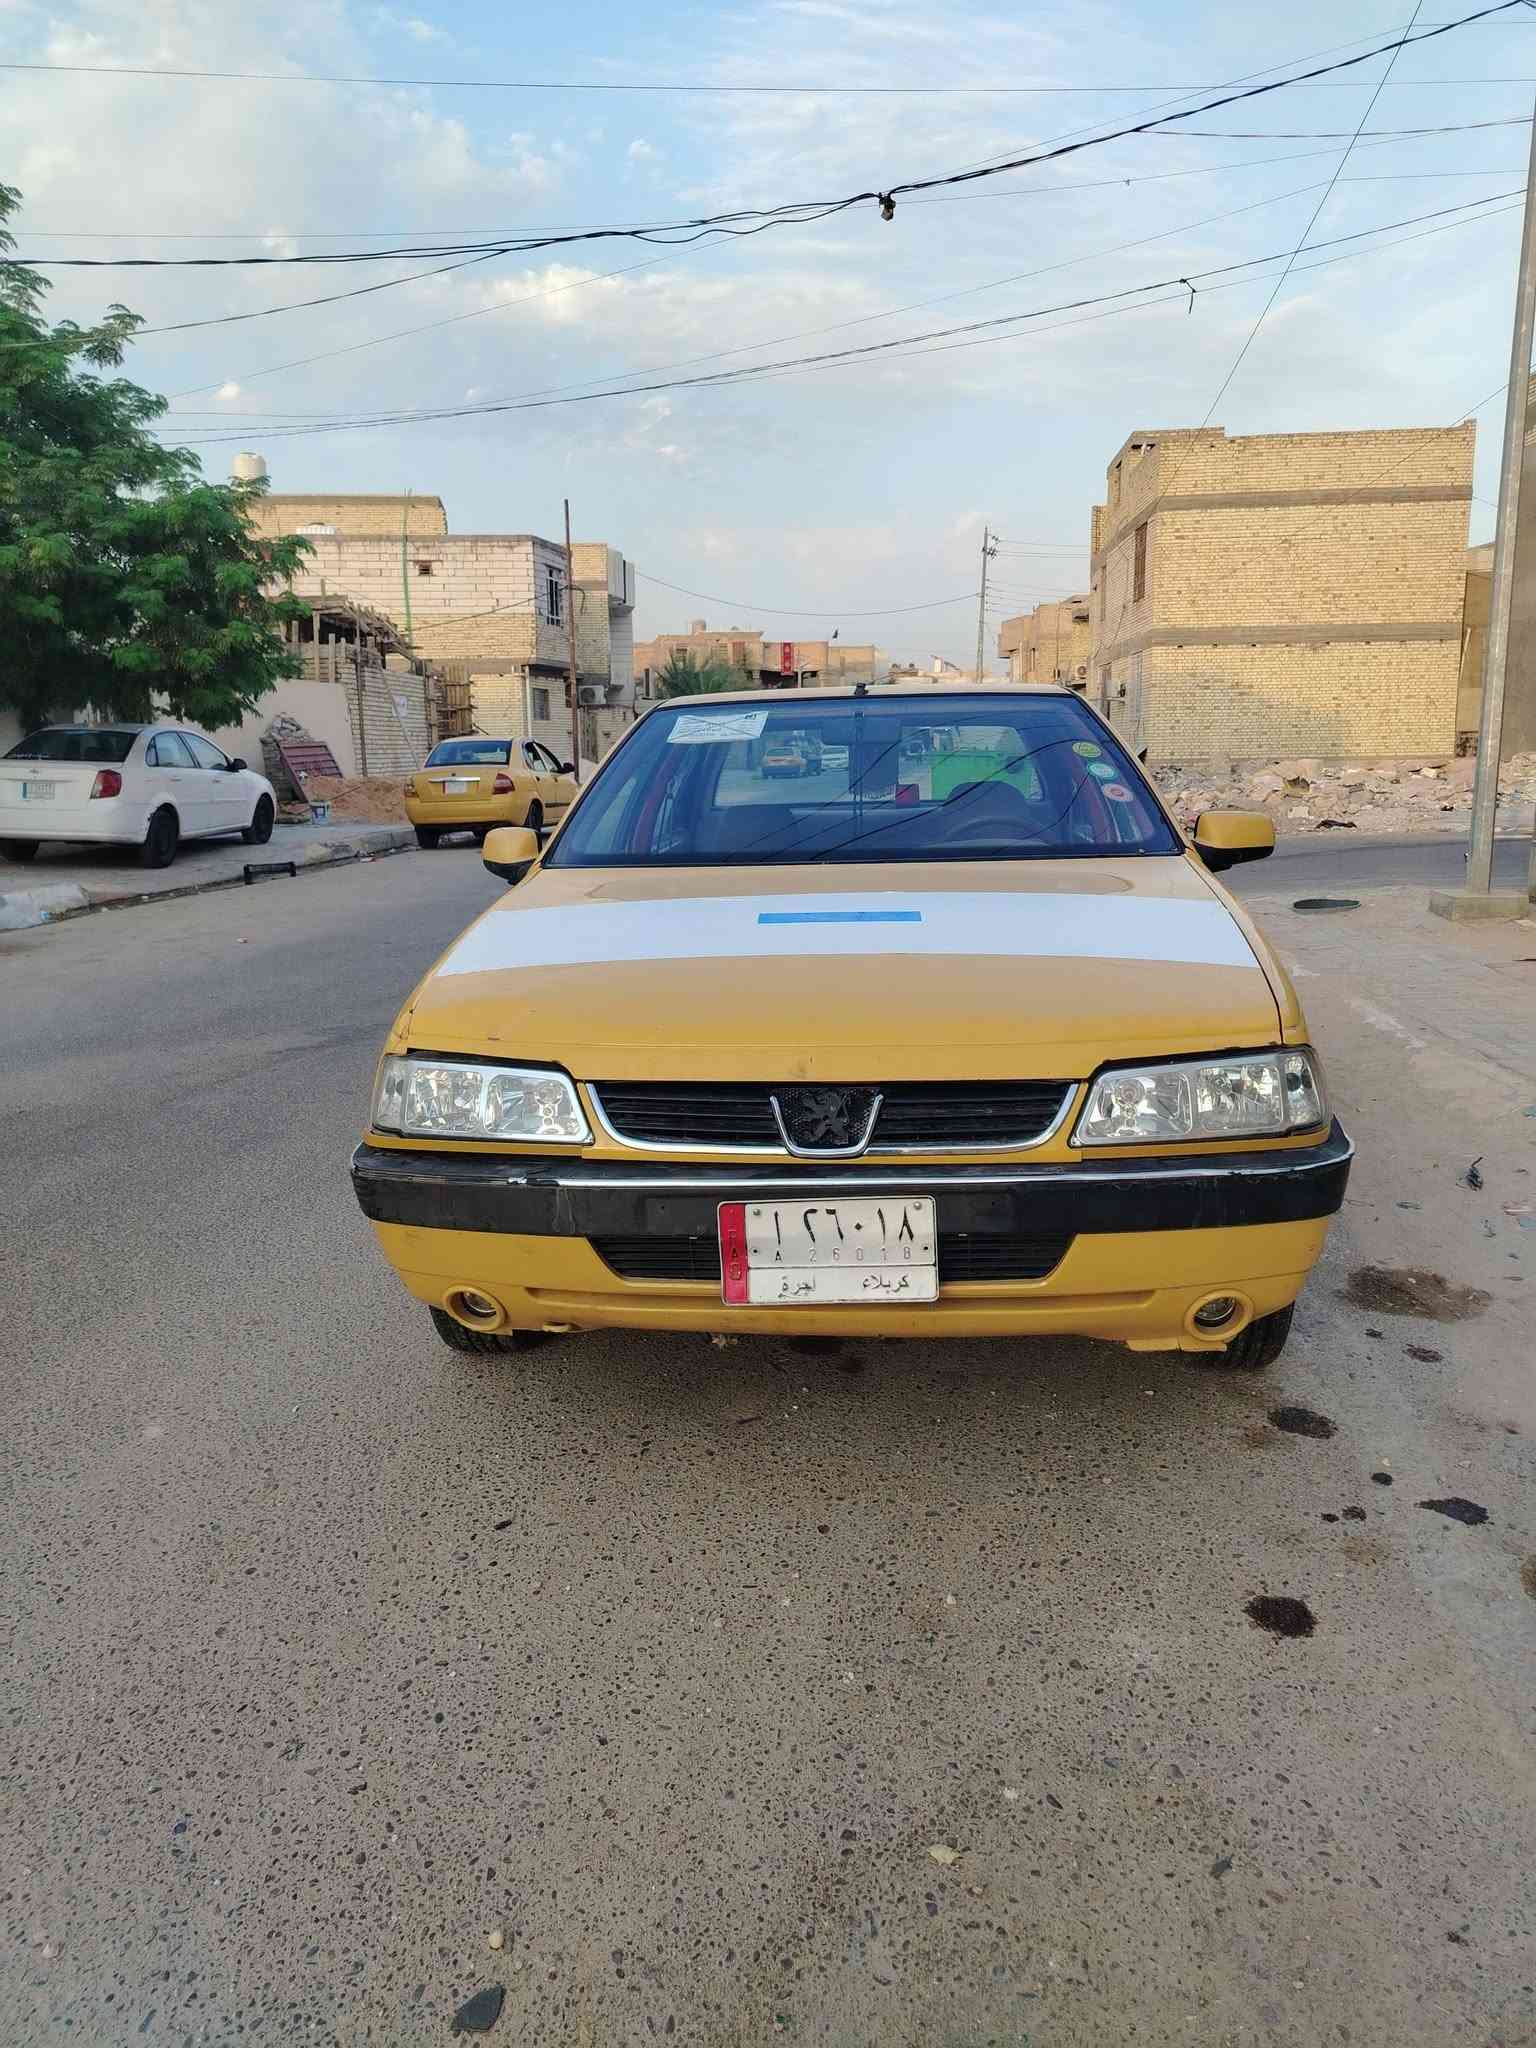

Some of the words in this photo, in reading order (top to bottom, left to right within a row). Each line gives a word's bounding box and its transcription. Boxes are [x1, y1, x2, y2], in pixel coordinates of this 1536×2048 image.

[803, 1205, 915, 1244] ٢٦٠١٨
[775, 1249, 784, 1263] A
[809, 1246, 911, 1264] 26018
[862, 1274, 910, 1294] كربلاء
